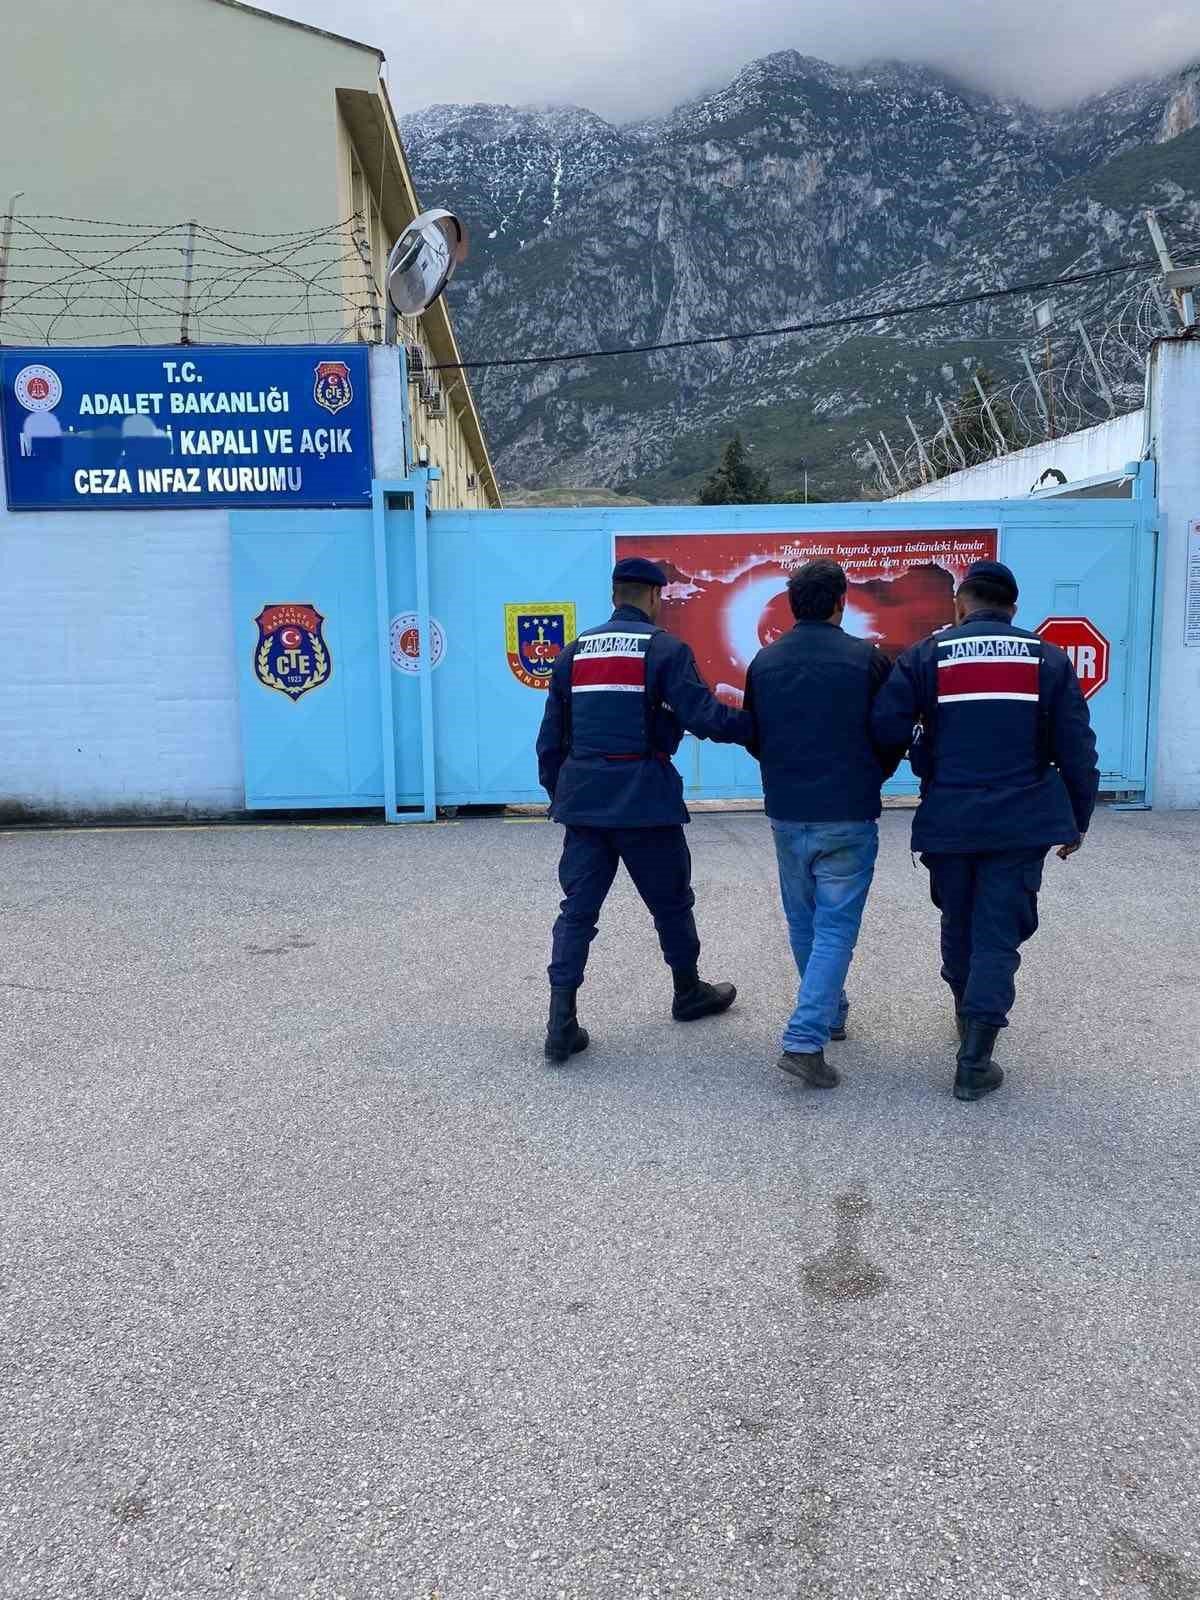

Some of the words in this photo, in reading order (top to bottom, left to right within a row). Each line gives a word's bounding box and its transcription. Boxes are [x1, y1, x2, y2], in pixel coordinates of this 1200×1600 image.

[163, 361, 203, 383] T.C.
[79, 393, 163, 415] ADALET
[170, 386, 289, 414] BAKANLIĞI
[180, 429, 258, 455] KAPALI
[264, 429, 293, 454] VE
[300, 428, 352, 459] AÇIK
[74, 469, 132, 494] CEZA
[207, 466, 302, 492] KURUMU
[837, 544, 869, 556] bayrak
[872, 545, 902, 556] yapan
[905, 541, 951, 553] üstündeki
[880, 556, 900, 568] ölen
[903, 558, 929, 567] varsa
[581, 637, 639, 654] JANDARMA
[946, 640, 1031, 659] JANDARMA
[276, 649, 311, 675] CTE
